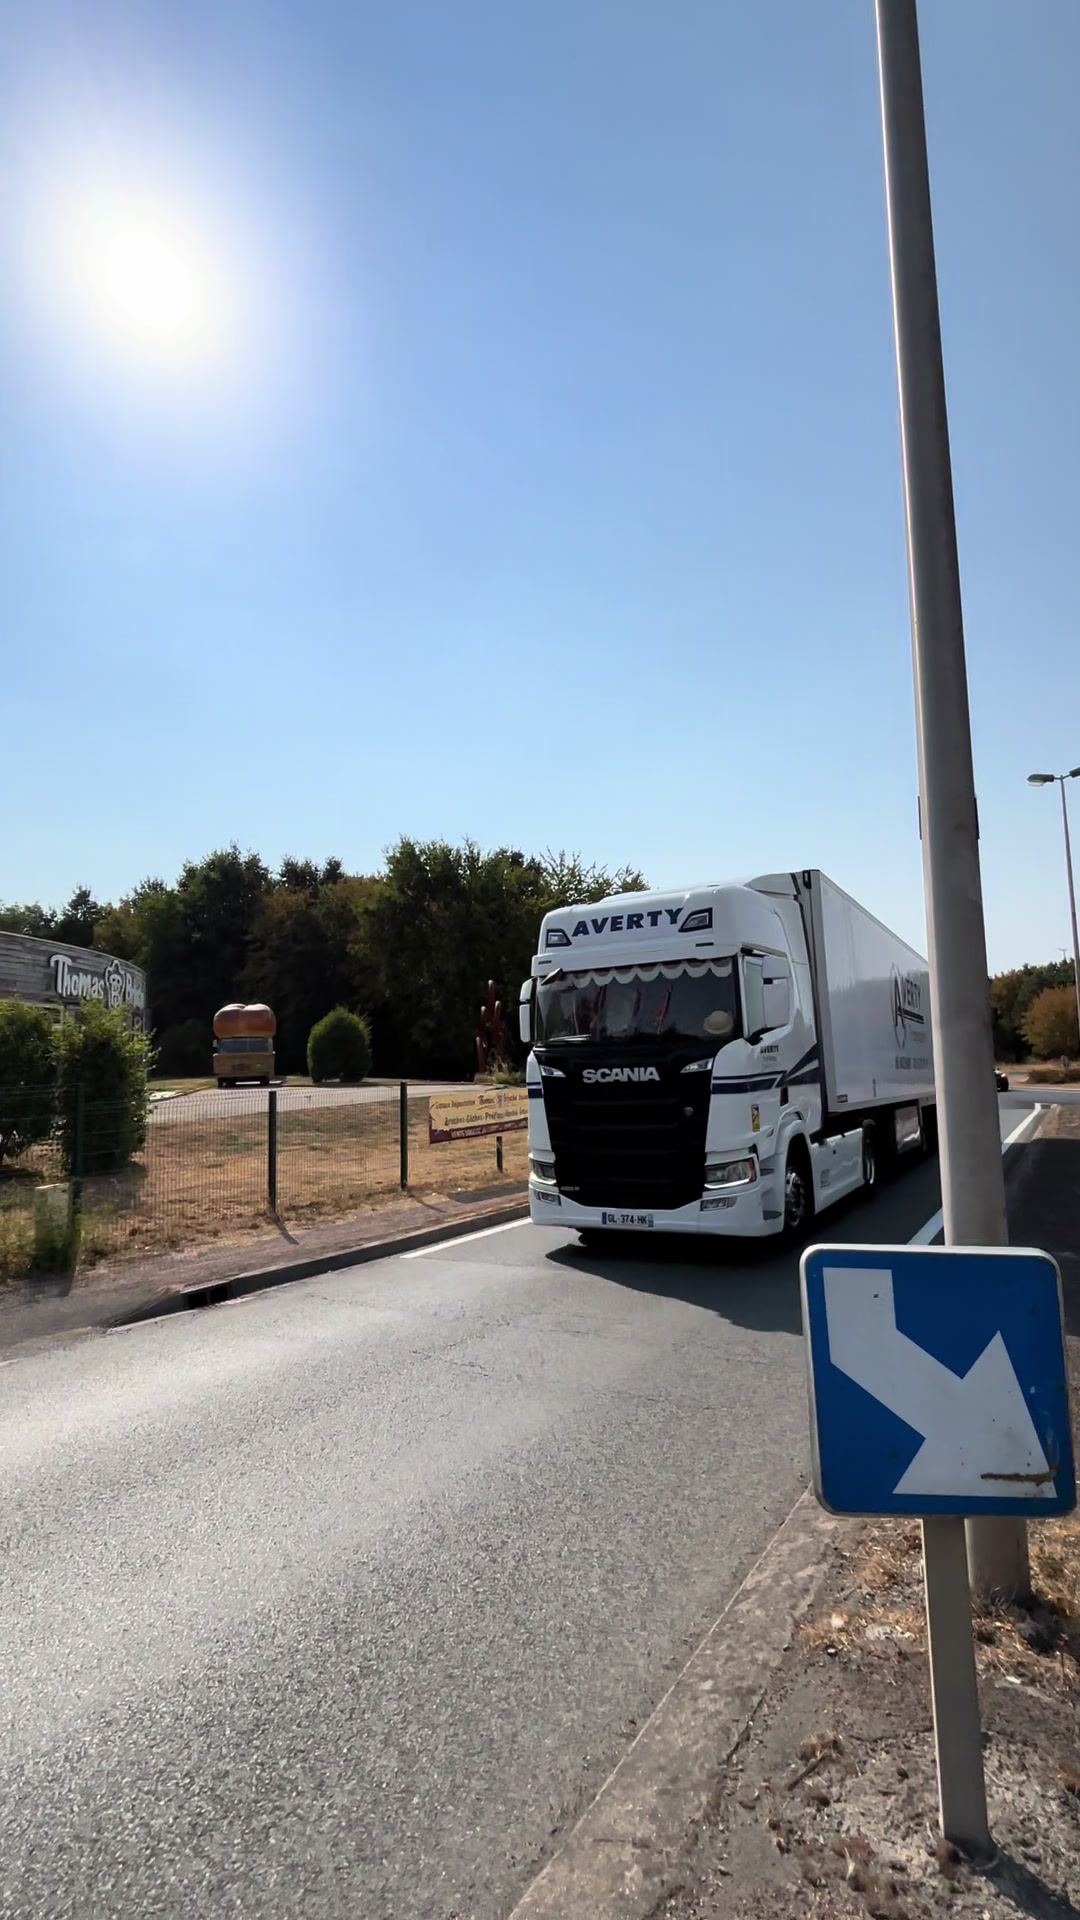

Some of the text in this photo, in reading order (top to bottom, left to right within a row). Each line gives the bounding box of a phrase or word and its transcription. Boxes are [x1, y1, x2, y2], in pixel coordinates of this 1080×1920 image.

[571, 907, 684, 938] AVERTY
[50, 954, 104, 999] Thomas
[582, 1066, 661, 1084] SCANIA
